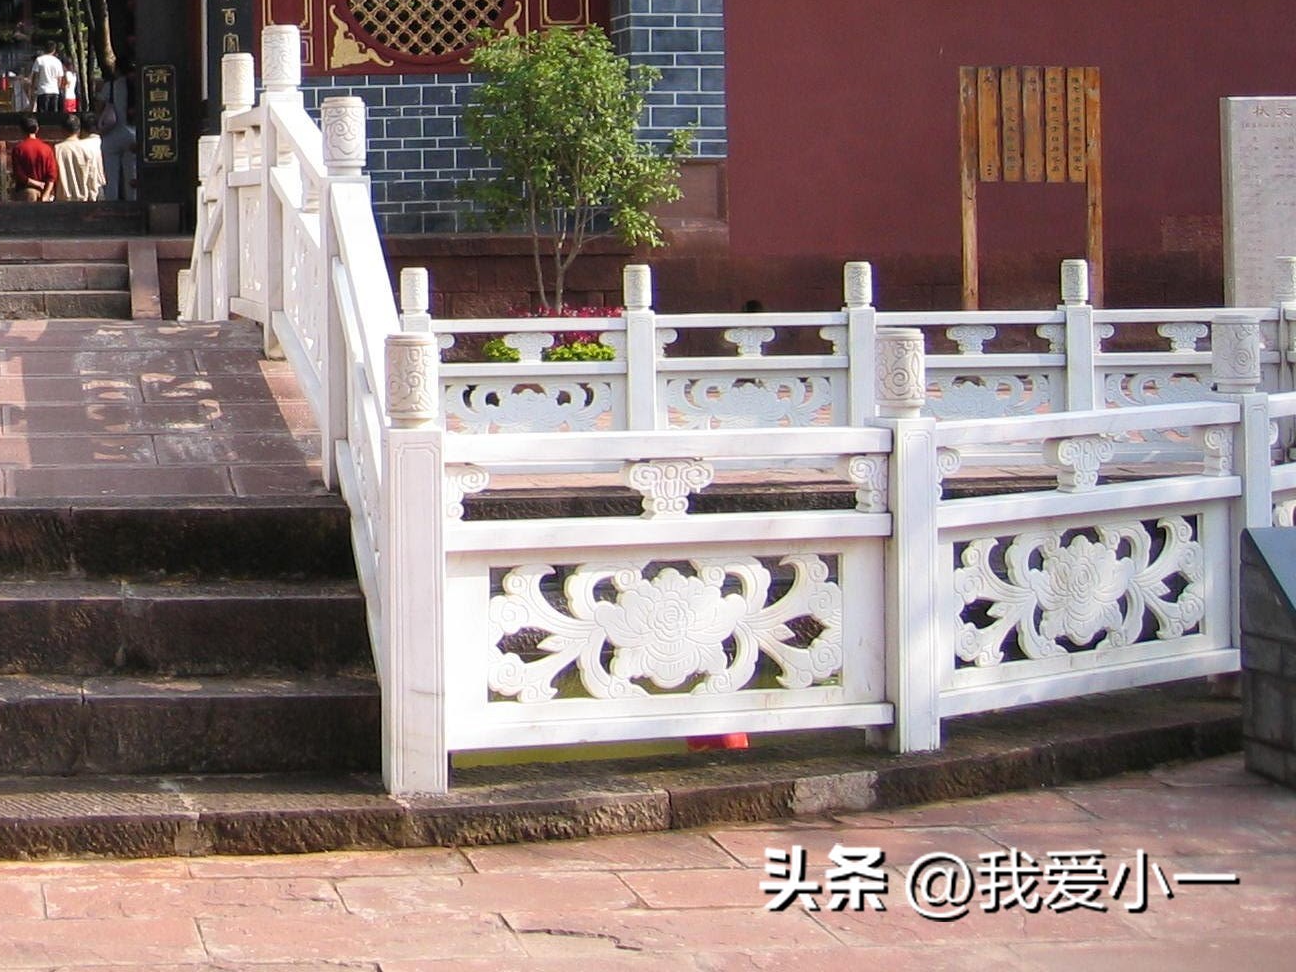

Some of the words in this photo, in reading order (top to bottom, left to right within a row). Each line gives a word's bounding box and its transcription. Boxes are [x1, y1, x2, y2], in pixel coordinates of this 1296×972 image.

[145, 69, 174, 161] 请自觉购票
